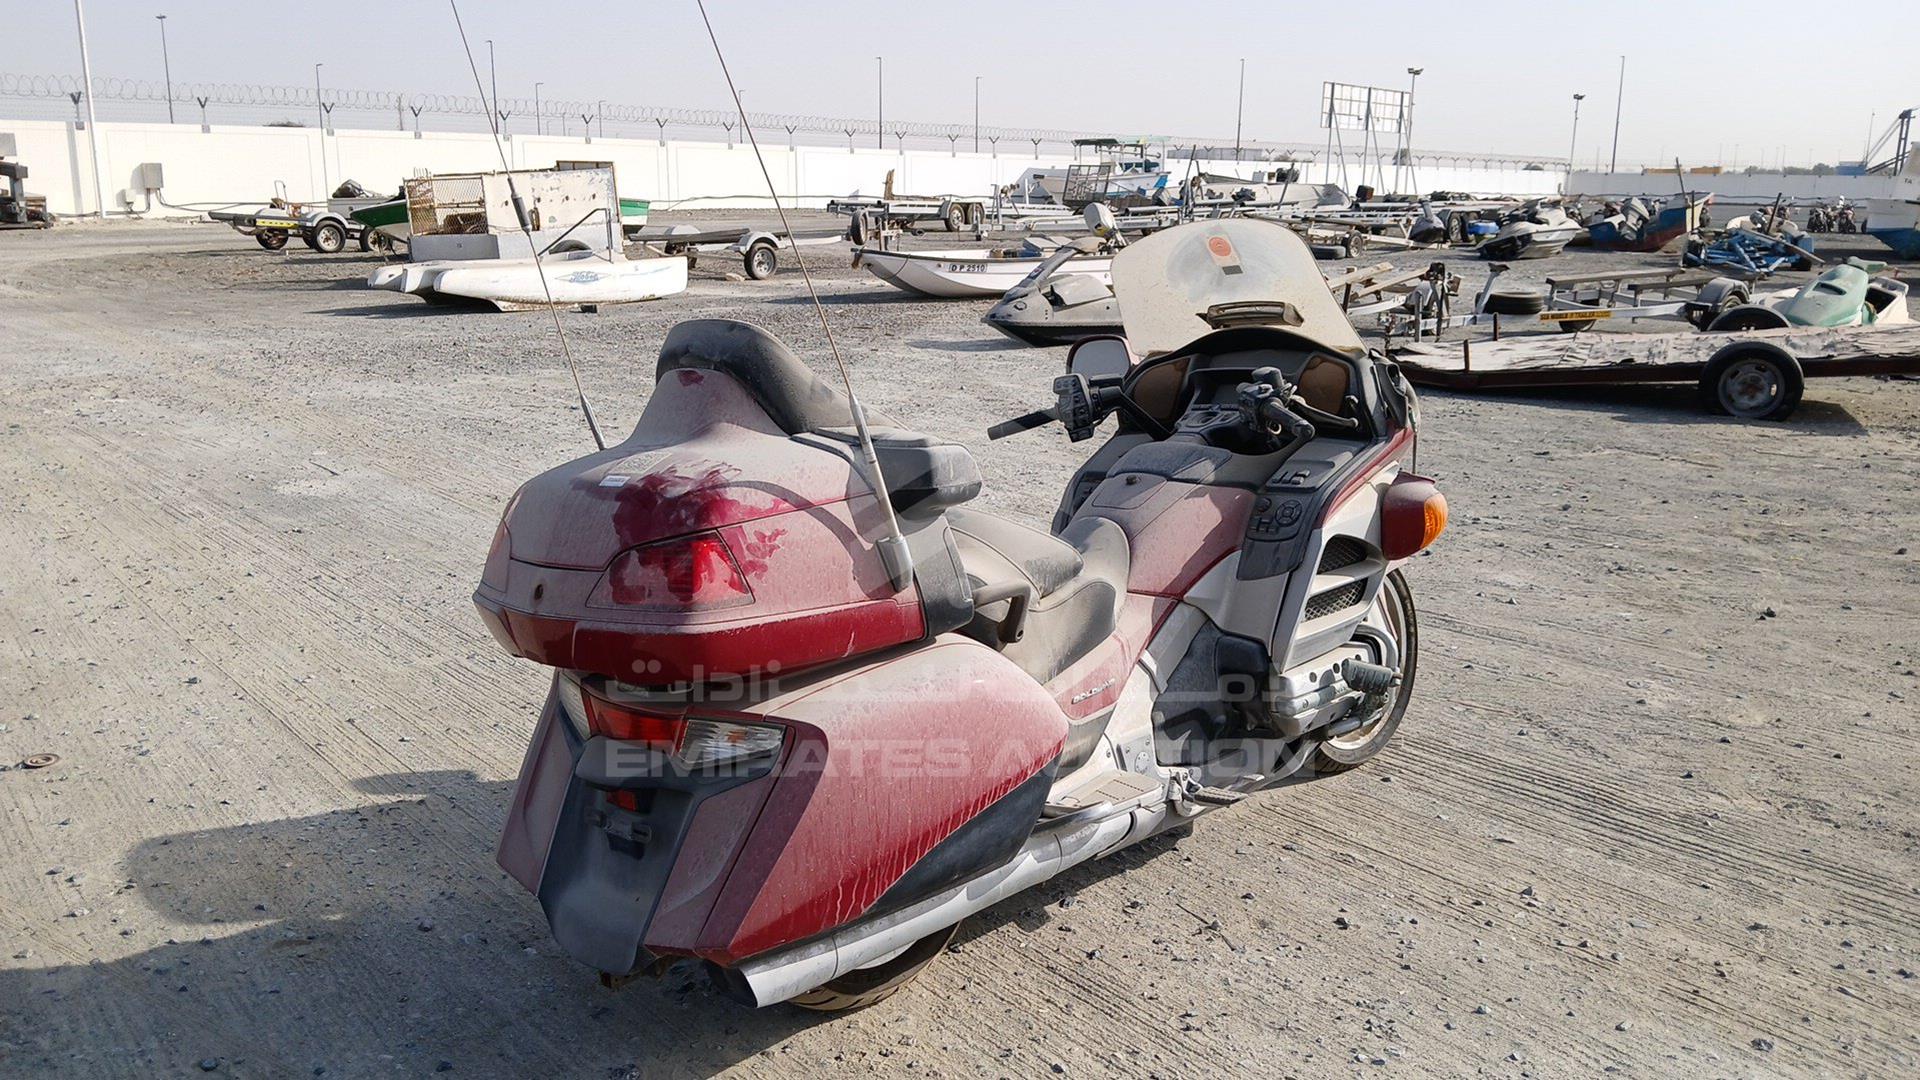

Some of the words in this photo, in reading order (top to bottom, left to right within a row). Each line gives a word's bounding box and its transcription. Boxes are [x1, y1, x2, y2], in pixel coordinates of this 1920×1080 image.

[959, 264, 965, 272] P
[966, 264, 985, 272] 2510
[1071, 678, 1116, 704] GOLD
